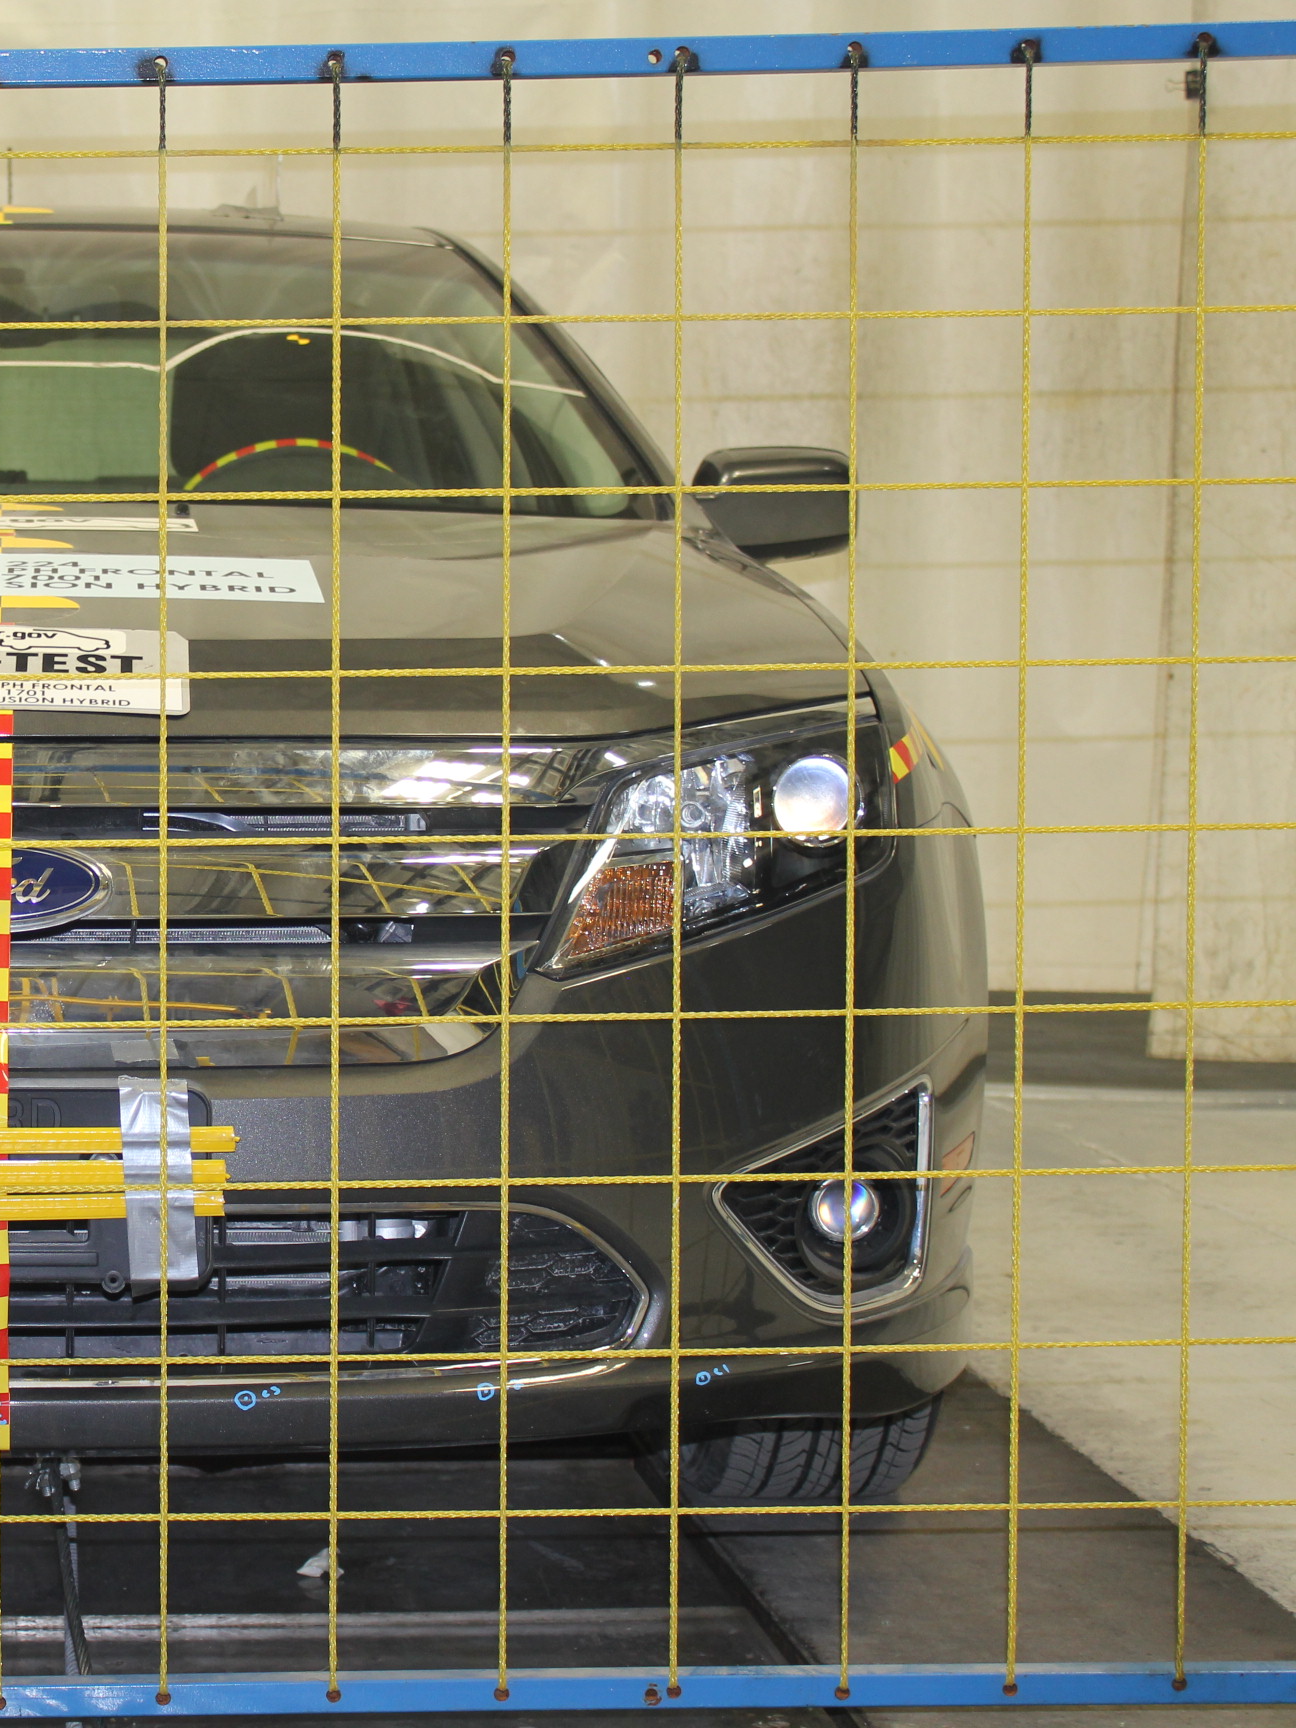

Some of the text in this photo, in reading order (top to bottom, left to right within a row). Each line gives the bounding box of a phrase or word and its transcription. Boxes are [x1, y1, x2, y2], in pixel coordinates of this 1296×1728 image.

[79, 568, 274, 578] FRONTAL
[137, 583, 296, 593] HYBRID
[32, 682, 115, 692] FRONTAL
[62, 698, 130, 706] HYBRID
